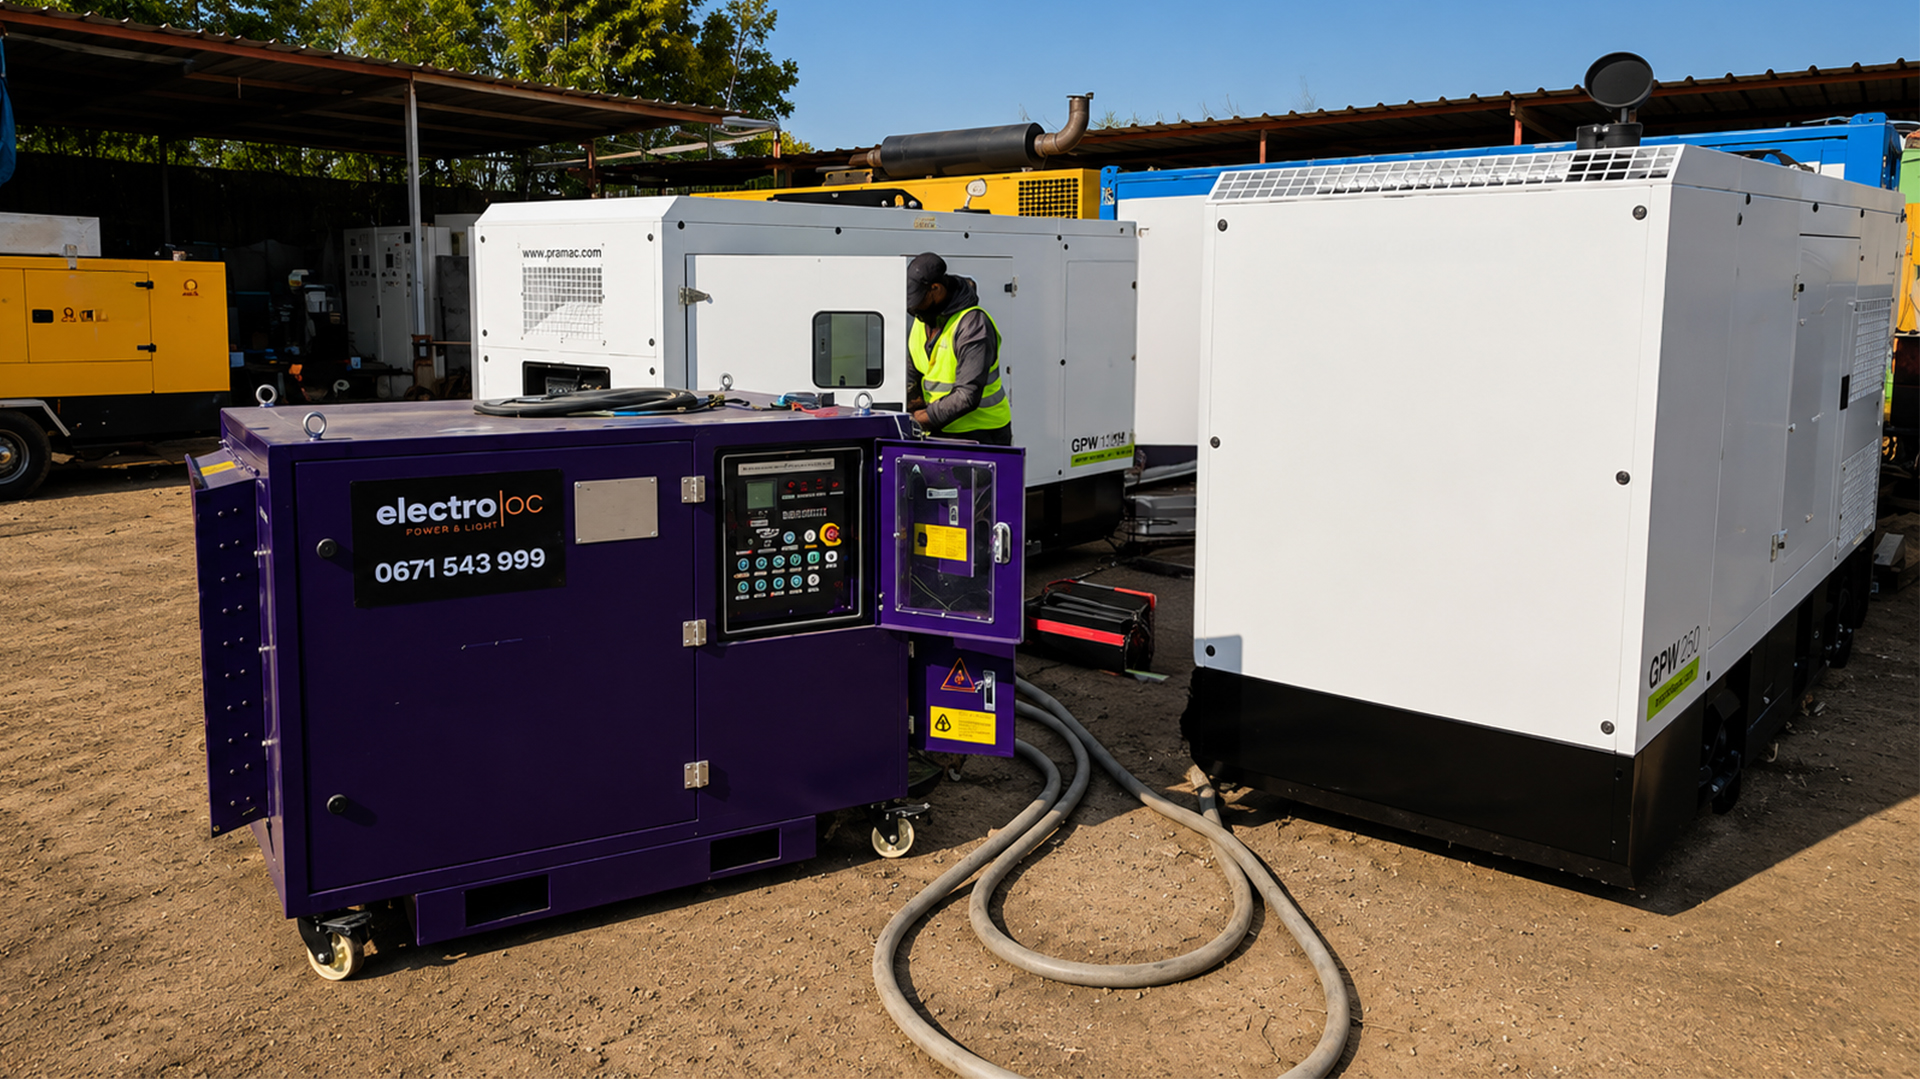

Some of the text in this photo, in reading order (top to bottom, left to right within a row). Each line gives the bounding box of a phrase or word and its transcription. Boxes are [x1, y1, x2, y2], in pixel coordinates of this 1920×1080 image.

[522, 248, 602, 262] www.pramac.com
[1071, 436, 1099, 453] GPW
[406, 525, 450, 537] POWER
[465, 520, 498, 532] LIGHT
[374, 547, 547, 584] 0671 543 999
[1648, 638, 1681, 690] GPW
[1680, 624, 1700, 664] 250
